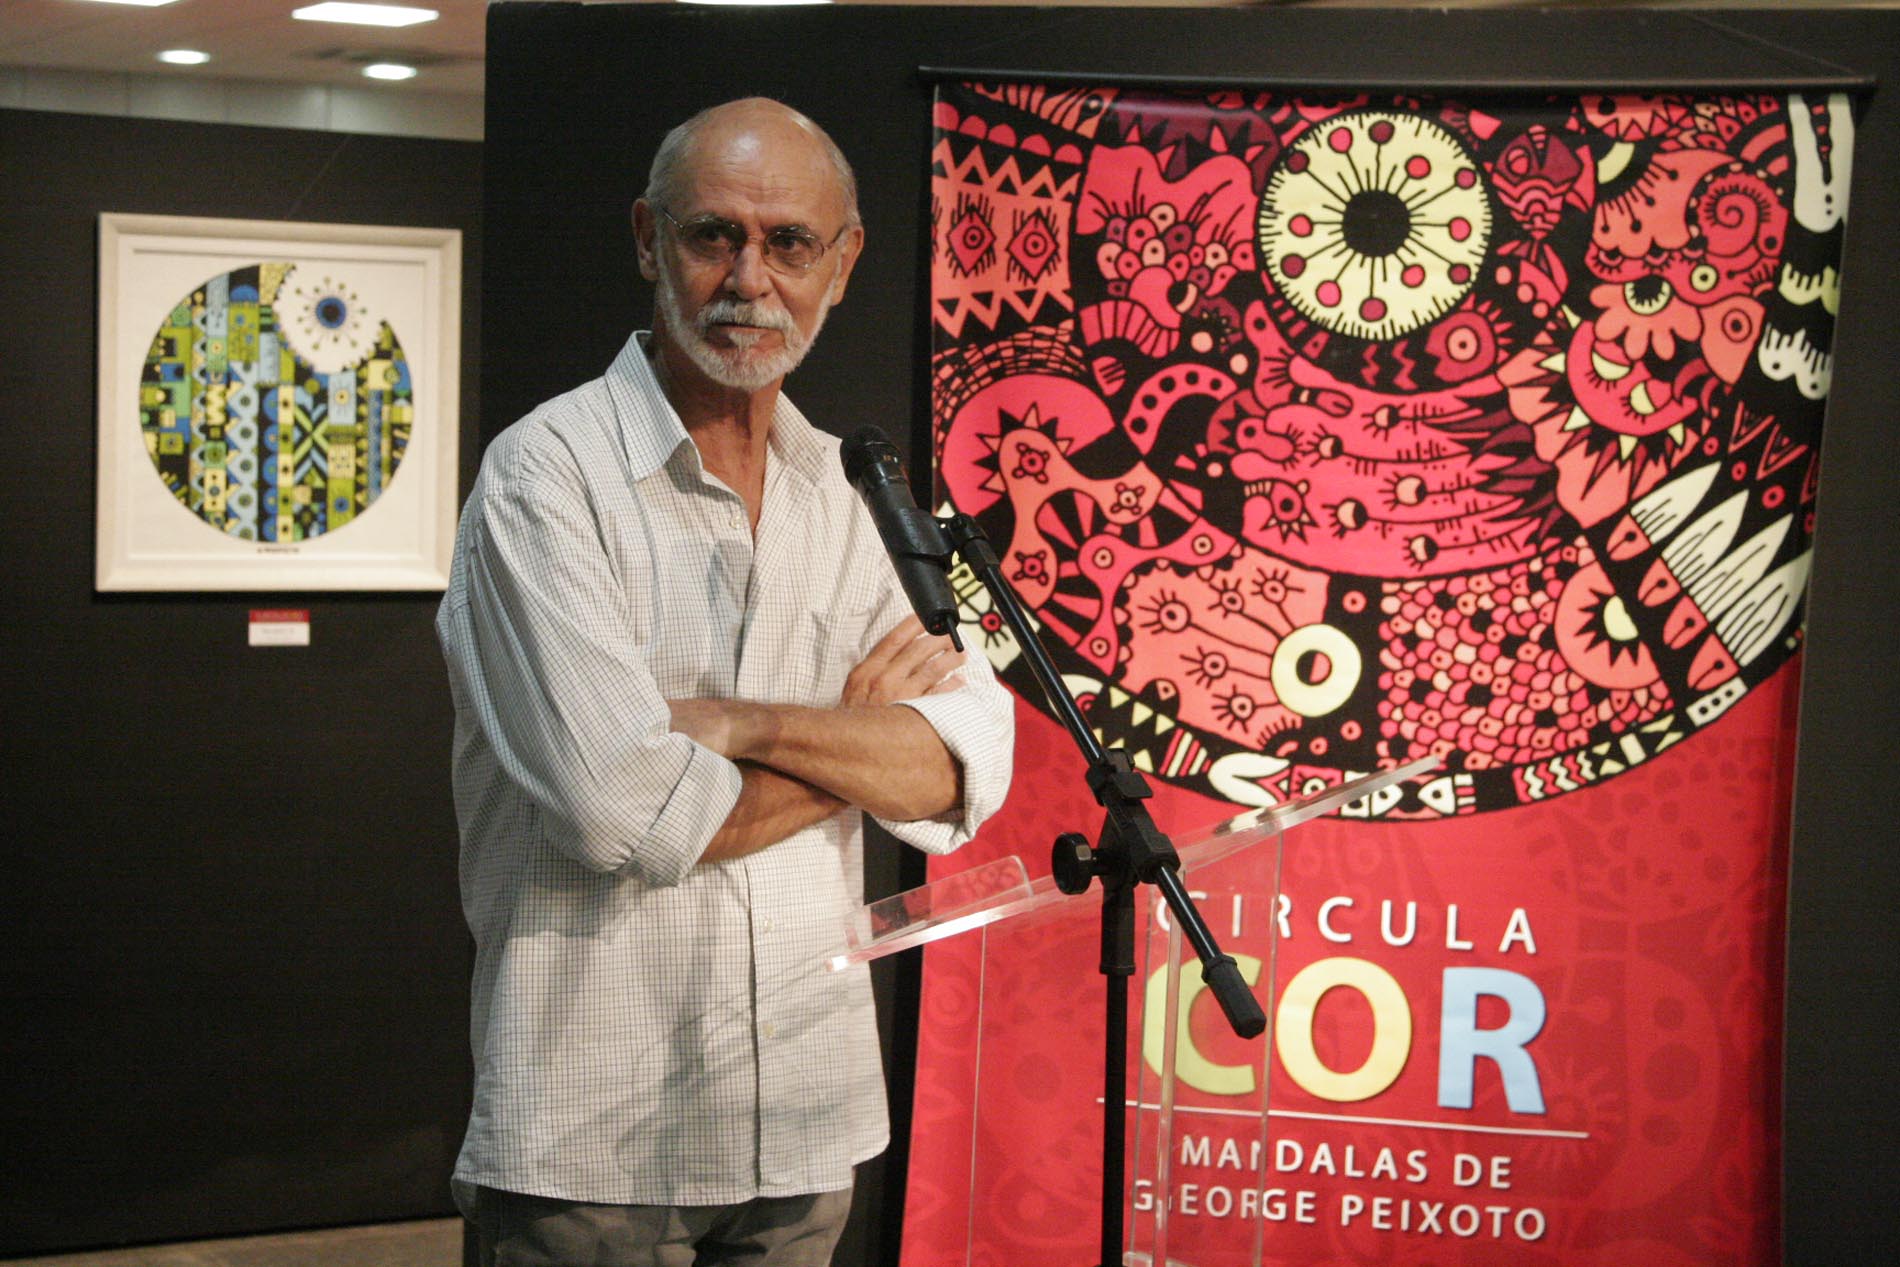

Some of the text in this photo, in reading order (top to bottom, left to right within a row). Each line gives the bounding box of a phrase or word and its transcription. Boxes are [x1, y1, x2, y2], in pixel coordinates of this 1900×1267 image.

[1142, 956, 1547, 1114] COR
[1453, 1153, 1512, 1189] DE
[1133, 1179, 1546, 1241] GEORGE PEIXOTO
